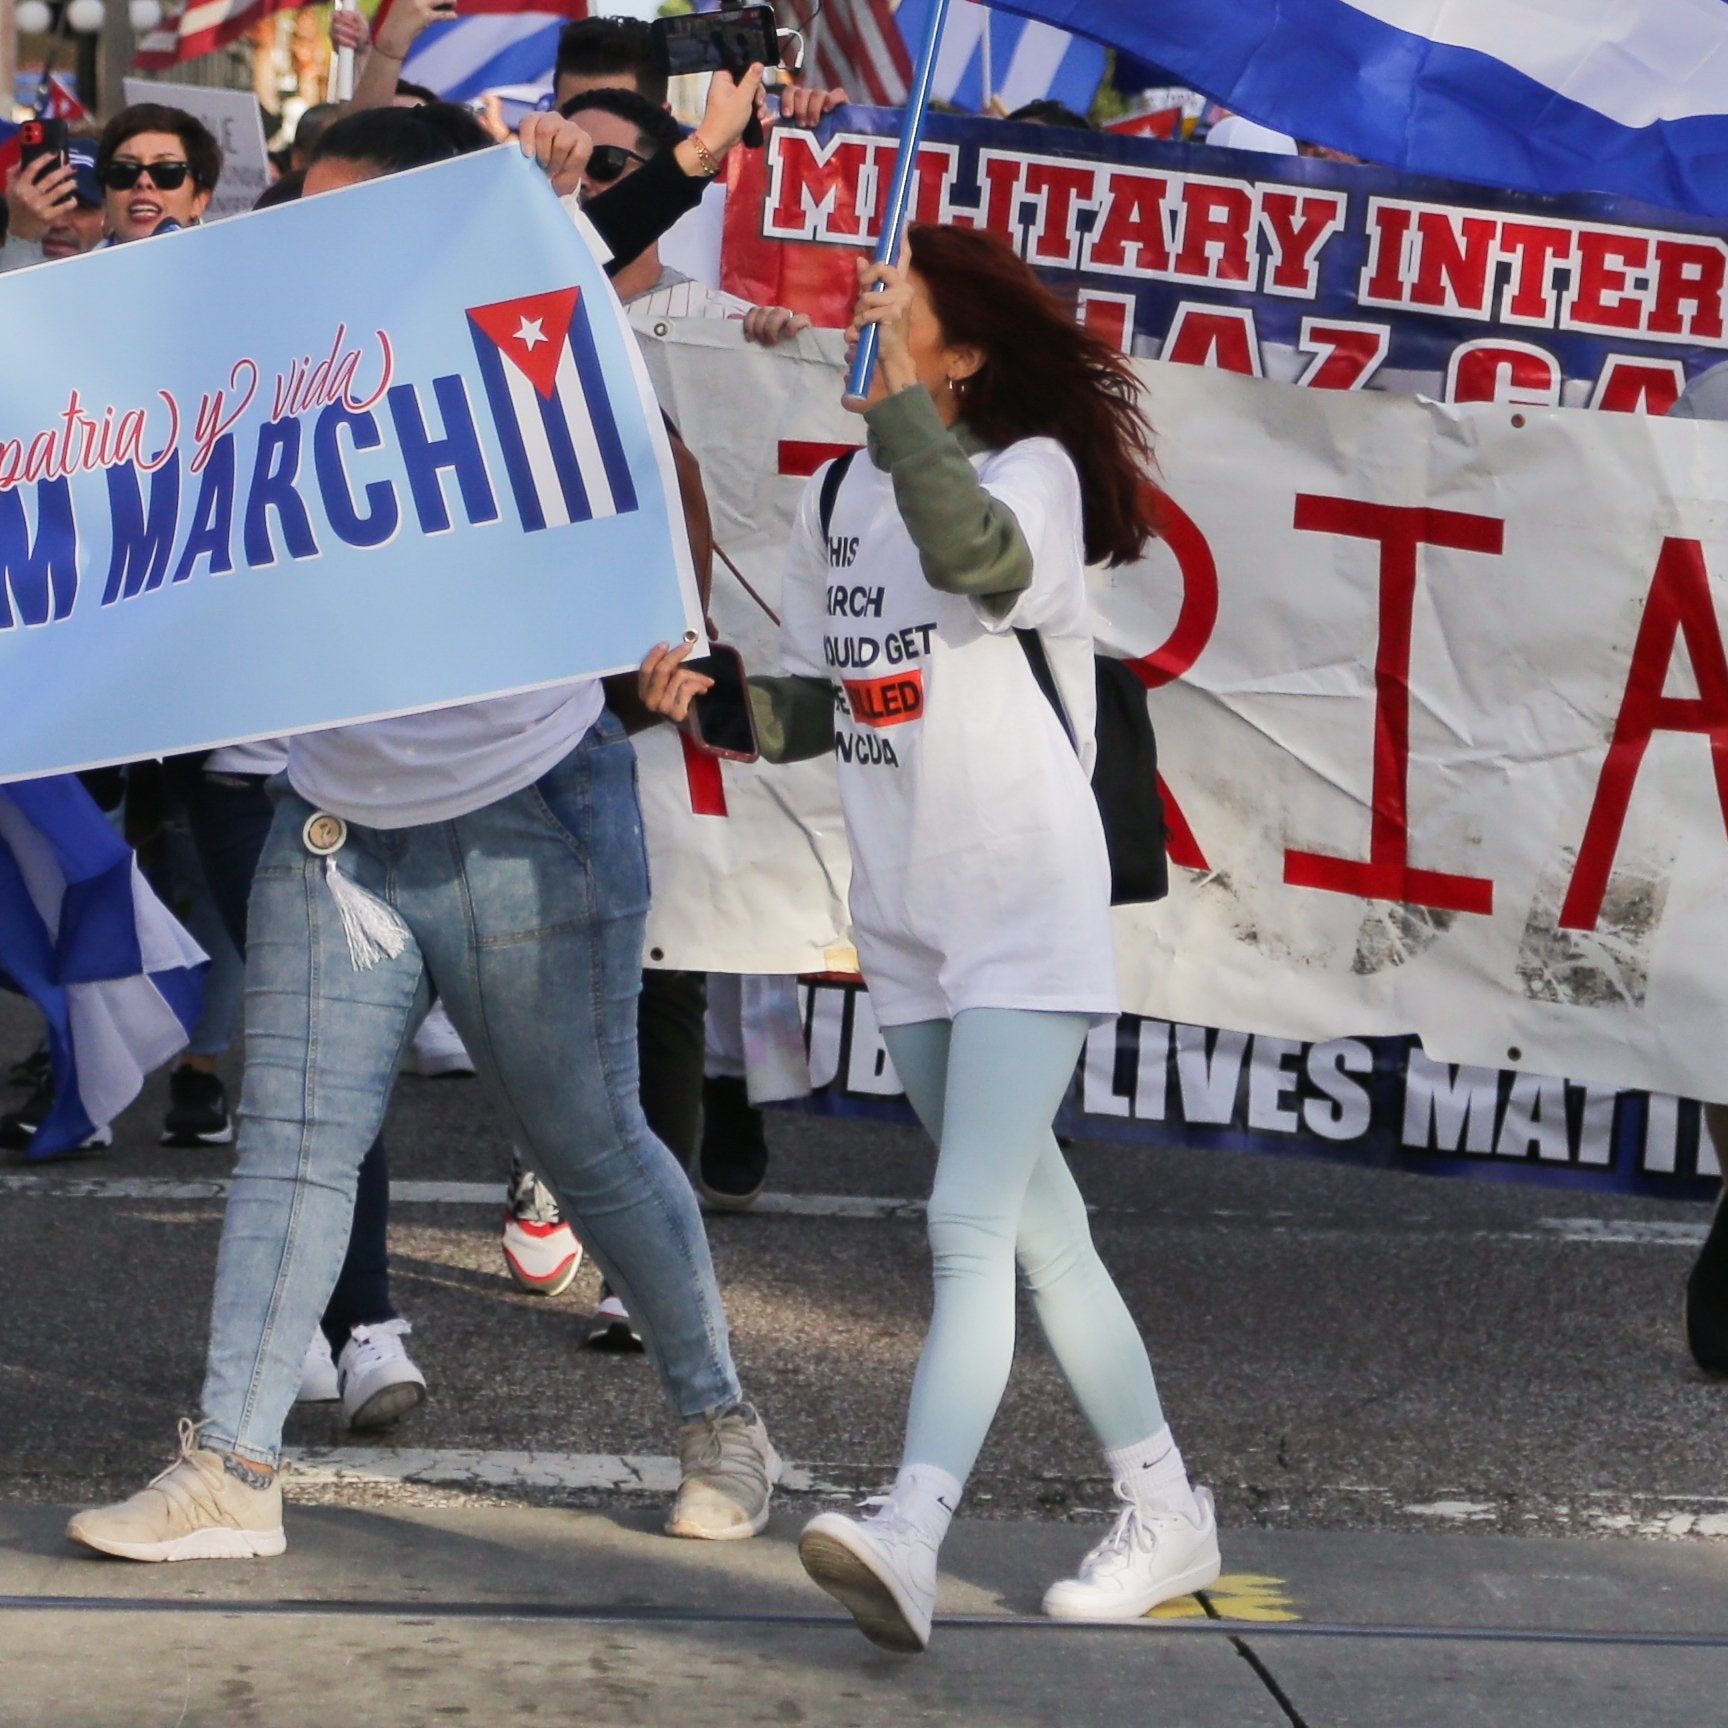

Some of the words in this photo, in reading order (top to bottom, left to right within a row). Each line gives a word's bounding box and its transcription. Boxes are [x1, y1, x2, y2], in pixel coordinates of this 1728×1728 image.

[763, 126, 1348, 300] MILITARY
[189, 357, 258, 475] y
[272, 322, 395, 425] vida
[100, 373, 502, 608] MARCH
[829, 536, 860, 568] HIS
[824, 633, 880, 669] OULD
[885, 622, 938, 665] GET
[1083, 1018, 1372, 1142] LIVES
